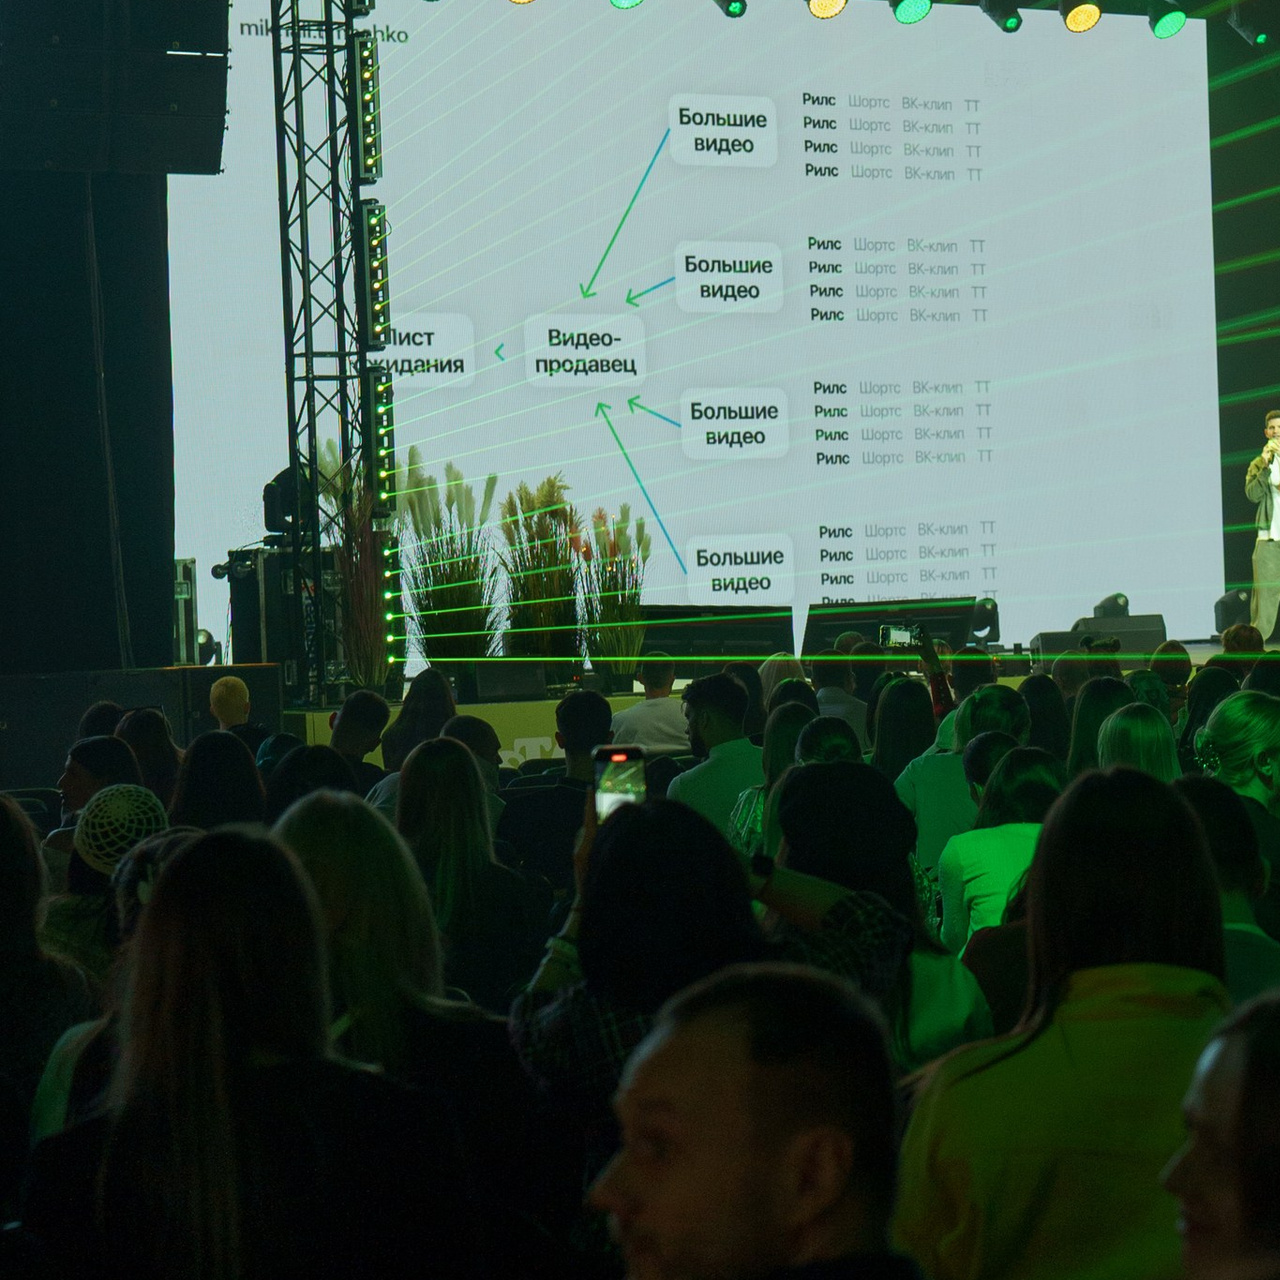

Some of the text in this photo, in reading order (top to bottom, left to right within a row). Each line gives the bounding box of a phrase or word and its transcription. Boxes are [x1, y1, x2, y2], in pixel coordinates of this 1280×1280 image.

[803, 93, 835, 106] Рилс
[849, 95, 890, 110] Шортс
[902, 96, 952, 110] ВК-клип
[679, 108, 767, 128] Большие
[804, 116, 836, 129] Рилс
[849, 118, 891, 133] Шортс
[903, 120, 953, 133] ВК-клип
[695, 138, 754, 155] видео
[805, 140, 837, 153] Рилс
[850, 141, 891, 157] Шортс
[904, 143, 954, 157] ВК-клип
[805, 163, 838, 177] Рилс
[851, 165, 892, 180] Шортс
[905, 166, 955, 180] ВК-клип
[808, 237, 841, 250] Рилс
[854, 238, 895, 253] Шортс
[907, 238, 957, 252] ВК-клип
[685, 256, 773, 273] Большие
[809, 261, 842, 273] Рилс
[855, 262, 896, 277] Шортс
[908, 262, 958, 275] ВК-клип
[701, 285, 760, 301] видео
[810, 284, 843, 297] Рилс
[856, 285, 897, 300] Шортс
[909, 285, 959, 298] ВК-клип
[811, 308, 844, 321] Рилс
[856, 308, 898, 323] Шортс
[910, 308, 960, 322] ВК-клип
[549, 329, 621, 350] Видео-
[536, 359, 637, 376] продавец
[814, 381, 847, 394] Рилс
[859, 381, 901, 396] Шортс
[913, 381, 963, 394] ВК-клип
[691, 402, 778, 420] Большие
[815, 405, 847, 417] Рилс
[860, 405, 901, 419] Шортс
[914, 404, 963, 417] ВК-клип
[706, 431, 765, 448] видео
[816, 429, 848, 441] Рилс
[861, 429, 903, 443] Шортс
[915, 428, 964, 440] ВК-клип
[816, 452, 849, 464] Рилс
[862, 452, 903, 466] Шортс
[915, 450, 965, 463] ВК-клип
[819, 526, 852, 538] Рилс
[865, 524, 906, 539] Шортс
[918, 523, 968, 536] ВК-клип
[697, 549, 784, 566] Большие
[820, 549, 853, 562] Рилс
[866, 548, 907, 562] Шортс
[919, 546, 969, 559] ВК-клип
[712, 577, 771, 594] видео
[821, 573, 854, 585] Рилс
[867, 572, 908, 586] Шортс
[920, 569, 969, 582] ВК-клип
